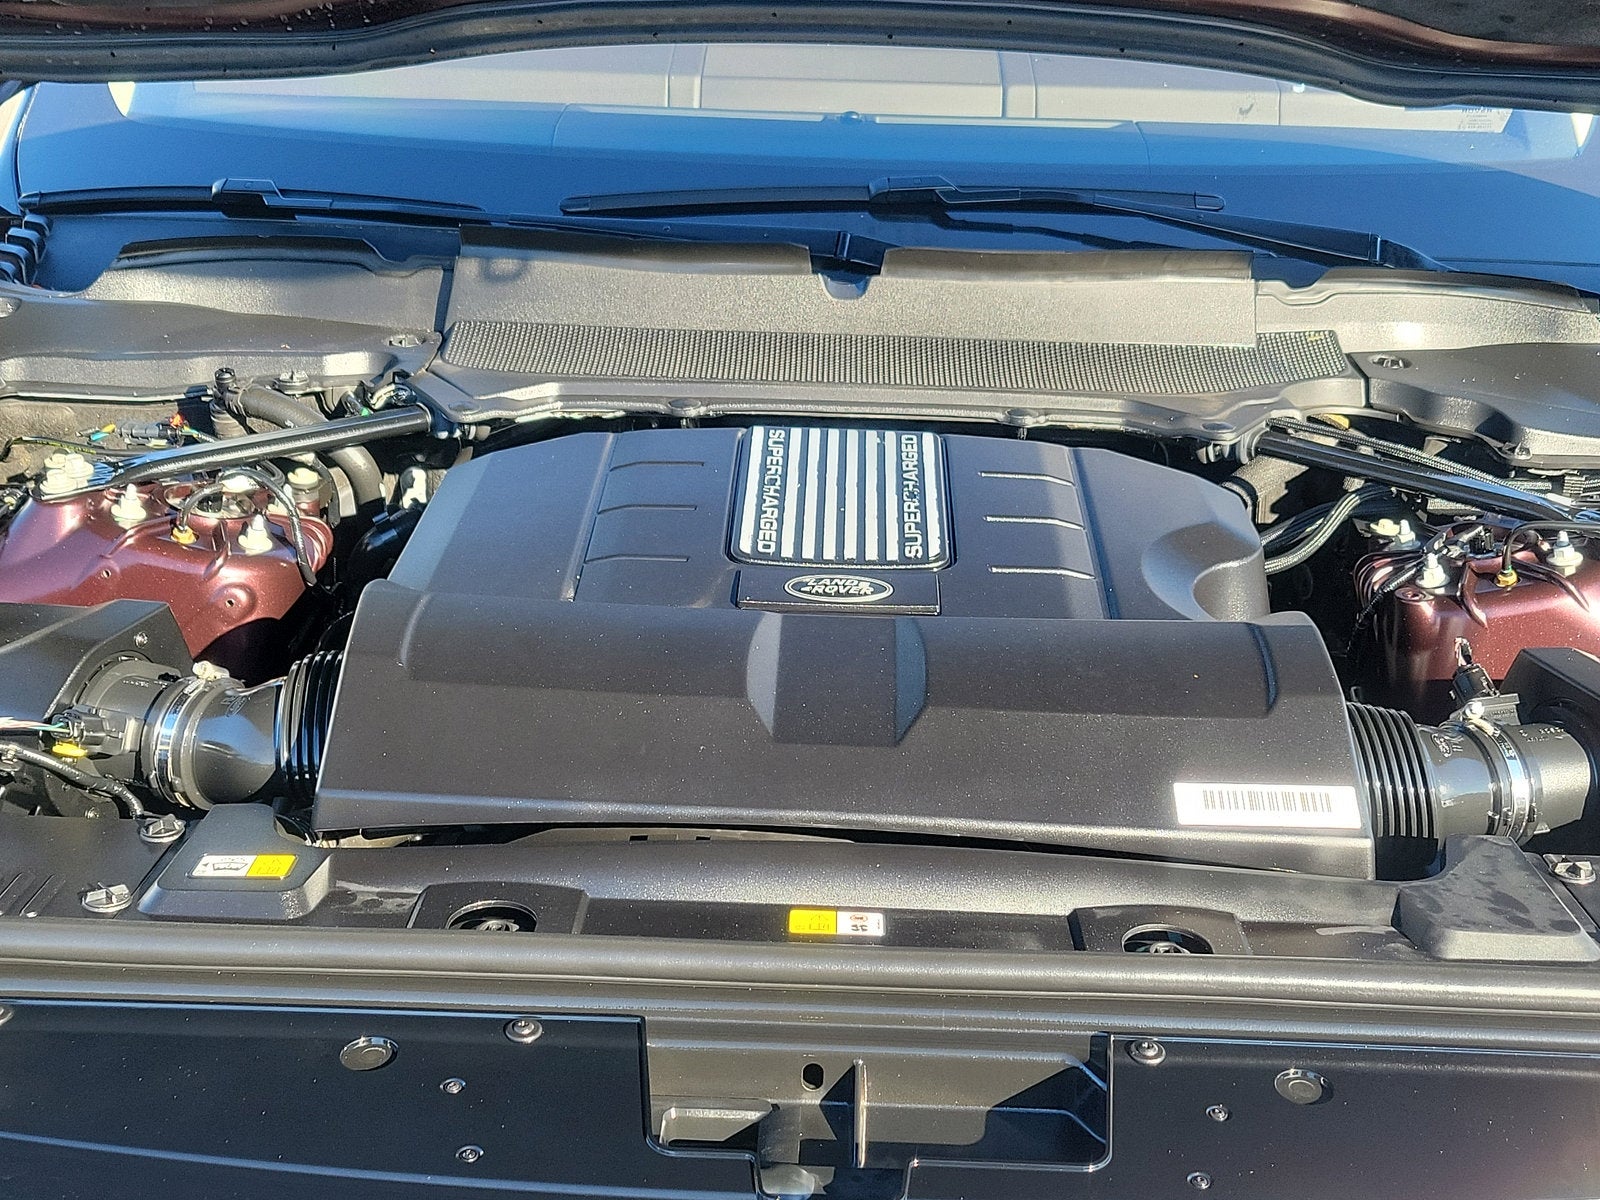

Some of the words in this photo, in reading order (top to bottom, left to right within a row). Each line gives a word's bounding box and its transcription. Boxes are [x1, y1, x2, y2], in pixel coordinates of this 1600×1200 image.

[757, 428, 786, 556] SUPERCHARGED
[900, 434, 923, 559] SUPERCHARGED
[807, 578, 859, 586] LAND
[811, 585, 874, 595] ROVER
